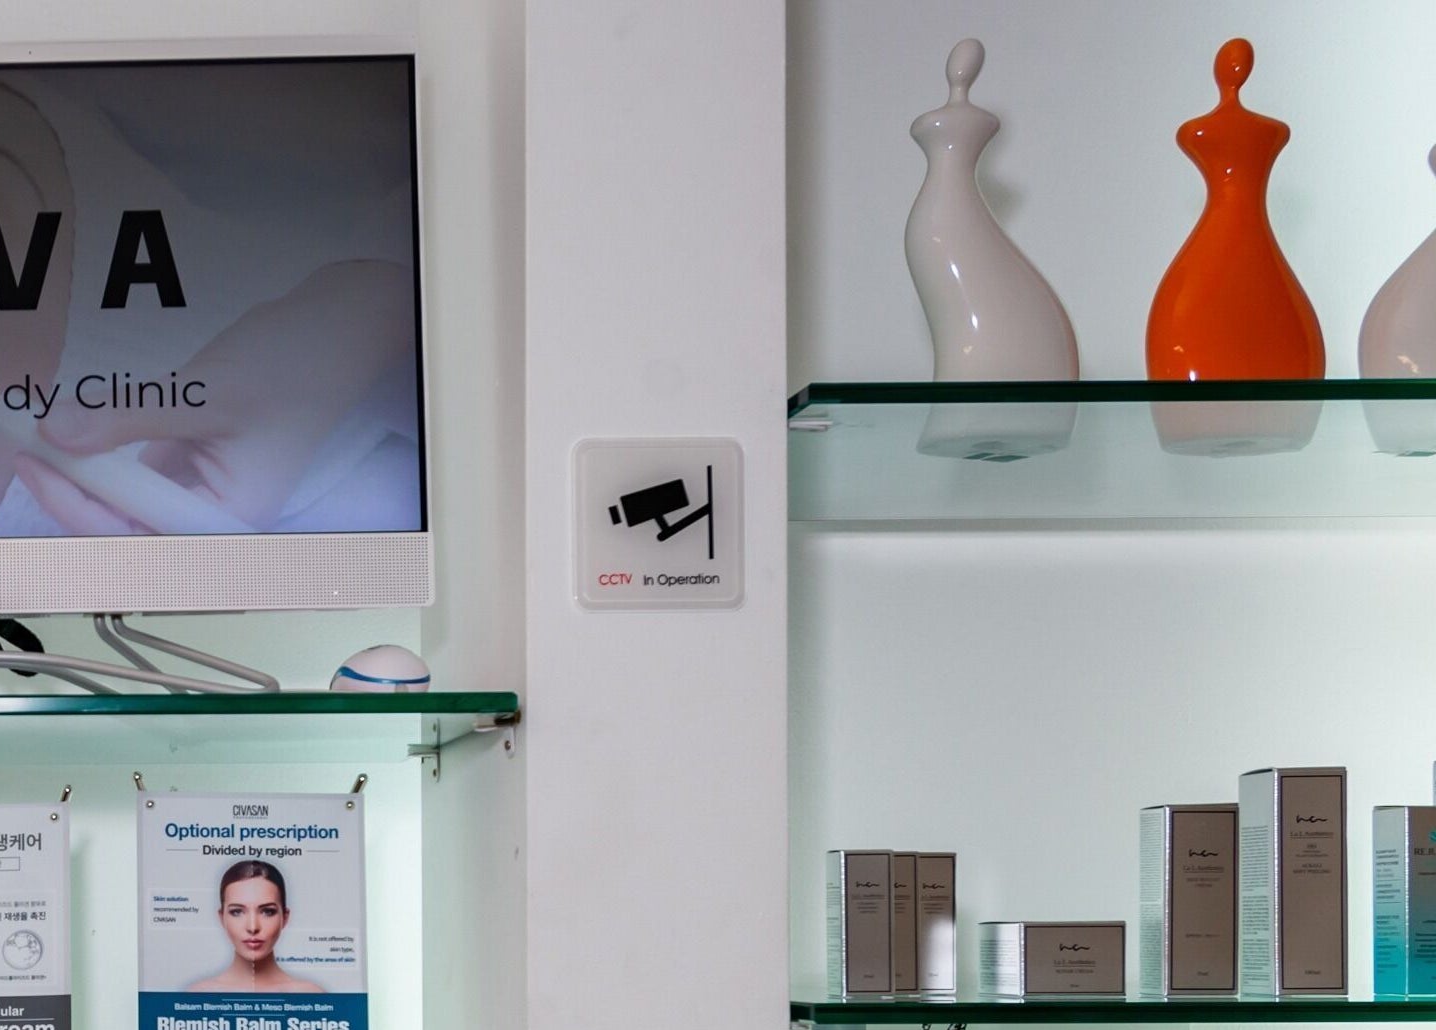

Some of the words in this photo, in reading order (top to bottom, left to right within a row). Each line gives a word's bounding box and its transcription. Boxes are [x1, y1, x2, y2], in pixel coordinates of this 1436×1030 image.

[75, 373, 207, 410] Clinic
[599, 574, 632, 585] CCTV
[644, 575, 654, 585] In
[657, 574, 720, 587] Operation
[233, 805, 268, 816] CIVASAN
[165, 823, 235, 841] Optional
[240, 826, 339, 841] prescription
[202, 845, 245, 856] Divided
[248, 845, 262, 858] by
[265, 847, 302, 858] region
[174, 1003, 201, 1011] Balsam
[204, 1003, 232, 1011] Blemish
[234, 1003, 252, 1011] Balm
[284, 1003, 313, 1011] Blemish
[315, 1003, 333, 1011] Balm
